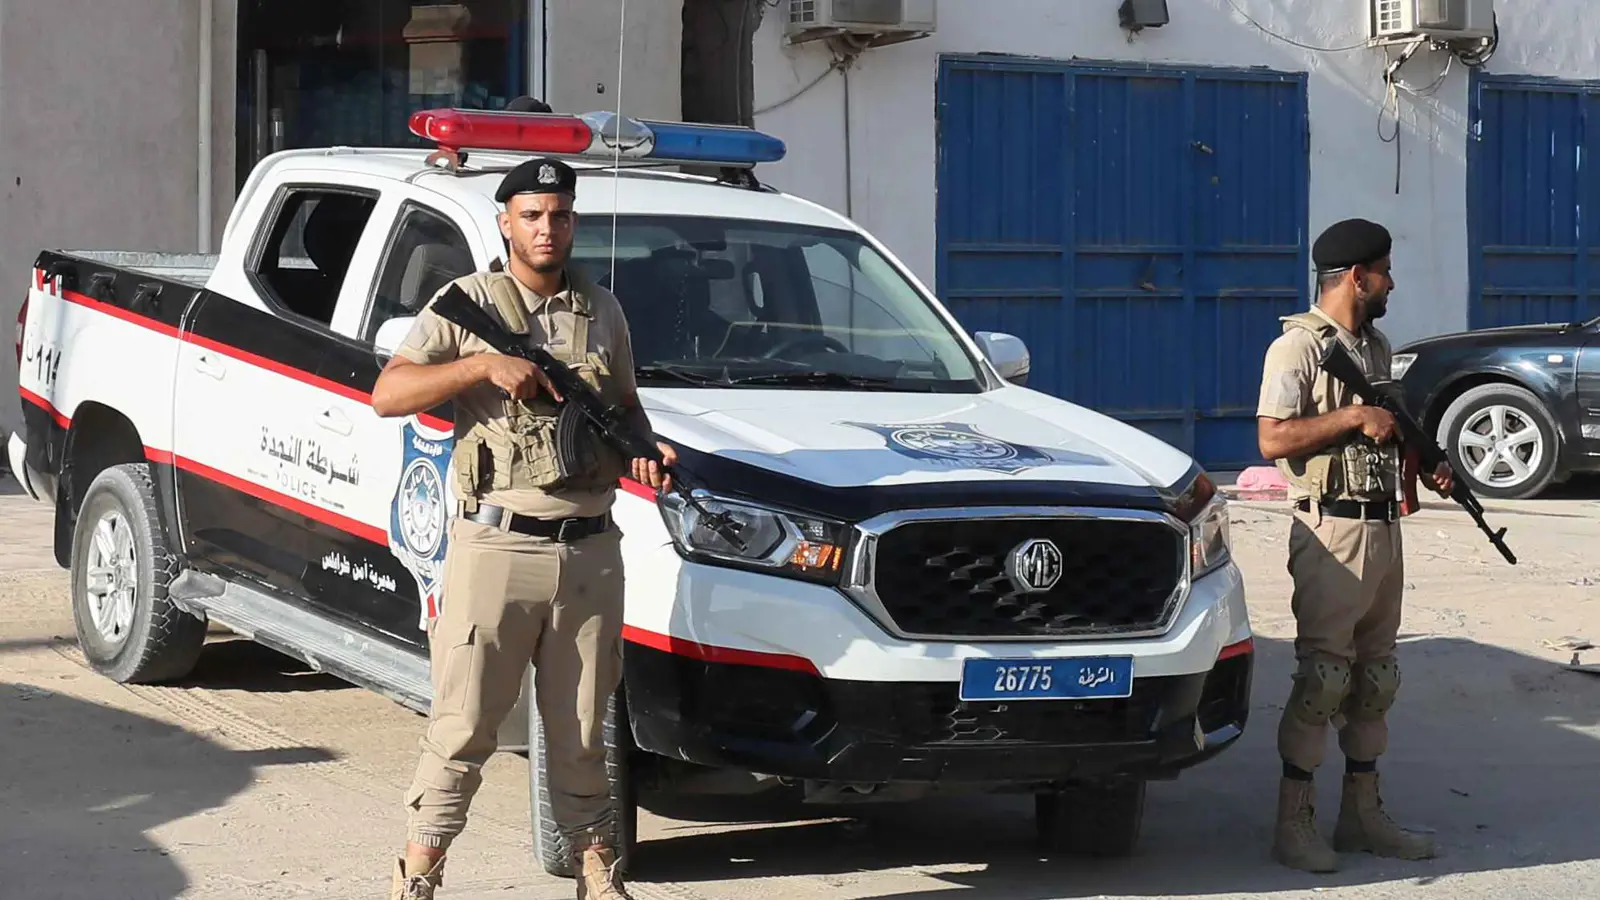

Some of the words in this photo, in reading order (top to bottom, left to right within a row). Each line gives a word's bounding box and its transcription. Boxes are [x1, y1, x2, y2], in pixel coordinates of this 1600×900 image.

[260, 425, 302, 469] النجدة
[306, 439, 360, 486] شرطة
[321, 551, 351, 576] طرابلس
[352, 557, 369, 581] أمن
[369, 563, 397, 592] مديرية
[1022, 543, 1059, 587] MG
[994, 665, 1053, 692] 26775
[1078, 667, 1114, 688] الشرطة
